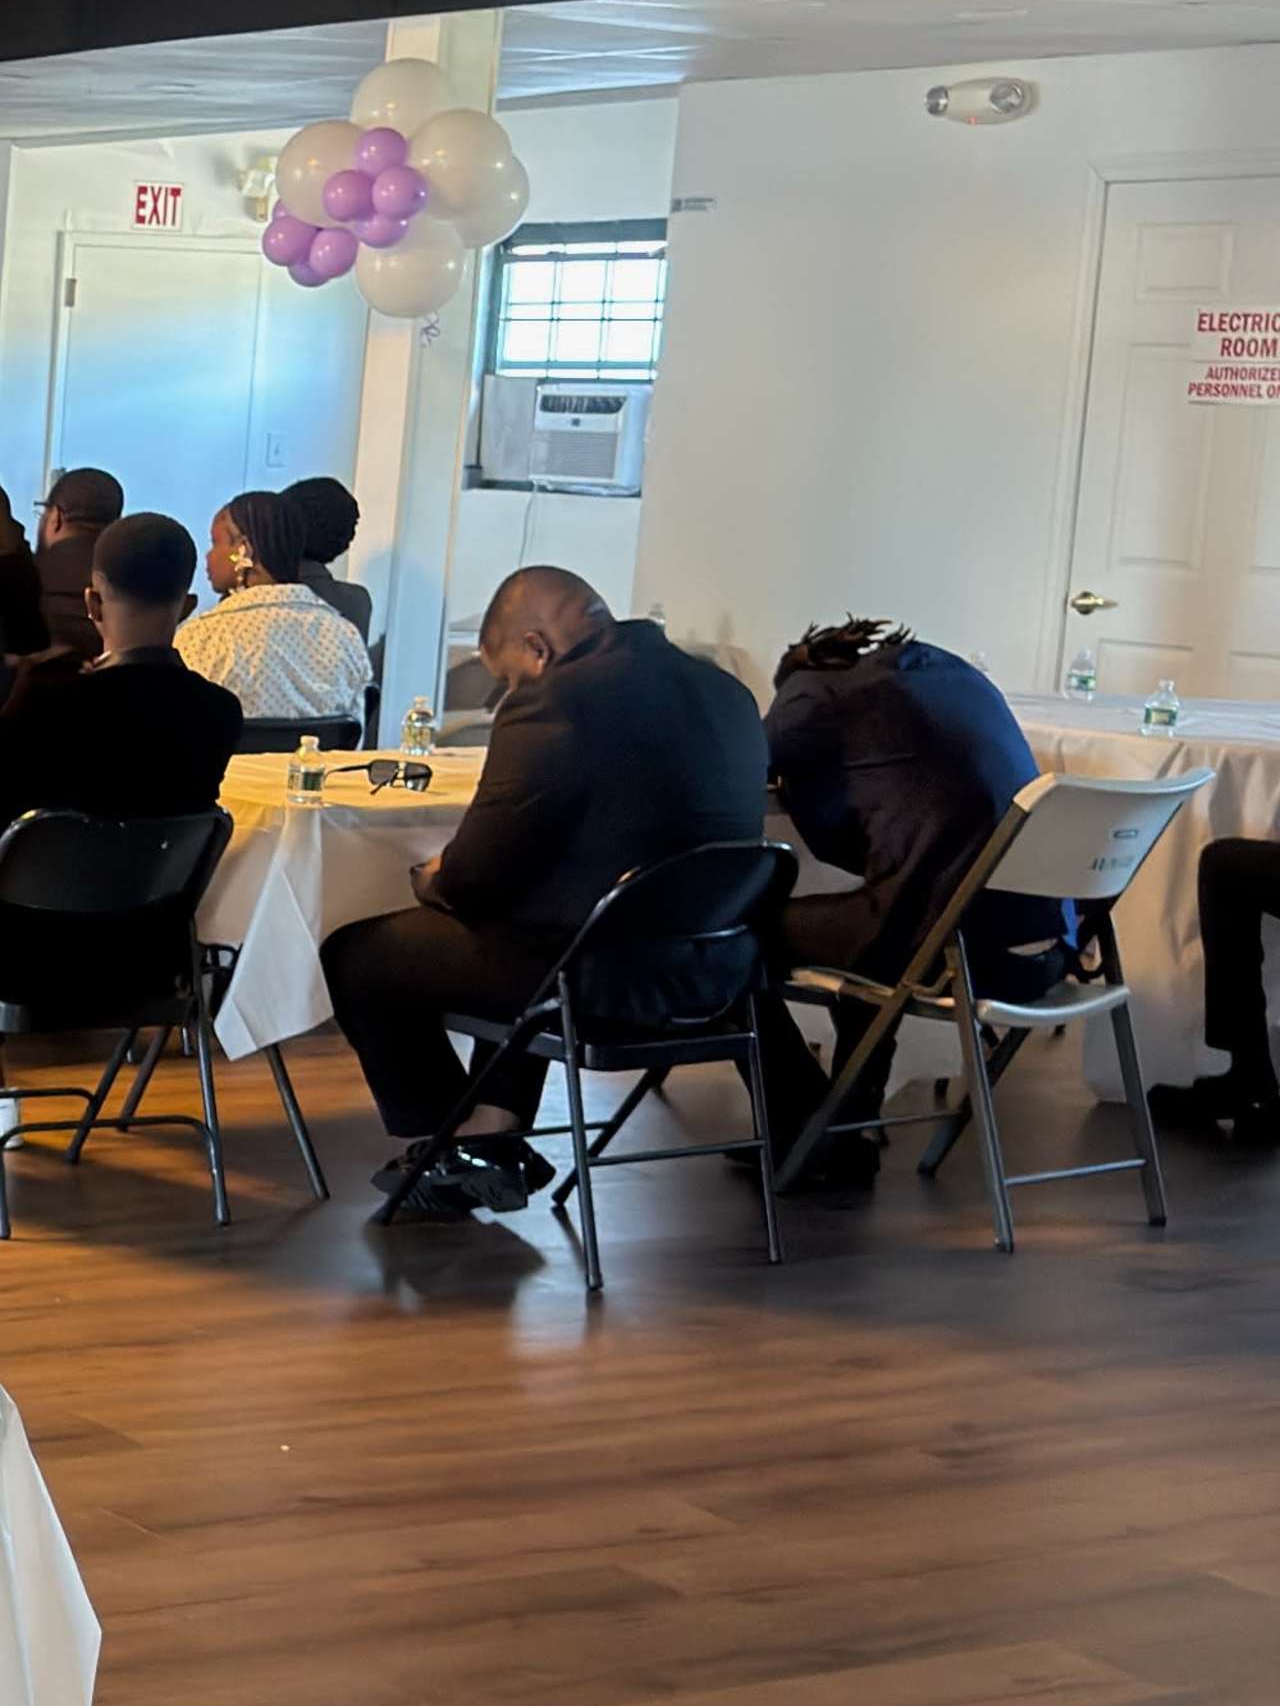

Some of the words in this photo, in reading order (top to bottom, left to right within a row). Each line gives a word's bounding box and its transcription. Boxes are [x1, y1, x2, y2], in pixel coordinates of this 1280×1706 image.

[134, 185, 182, 225] EXIT
[1220, 337, 1277, 357] ROOM
[1187, 382, 1264, 399] PERSONNEL
